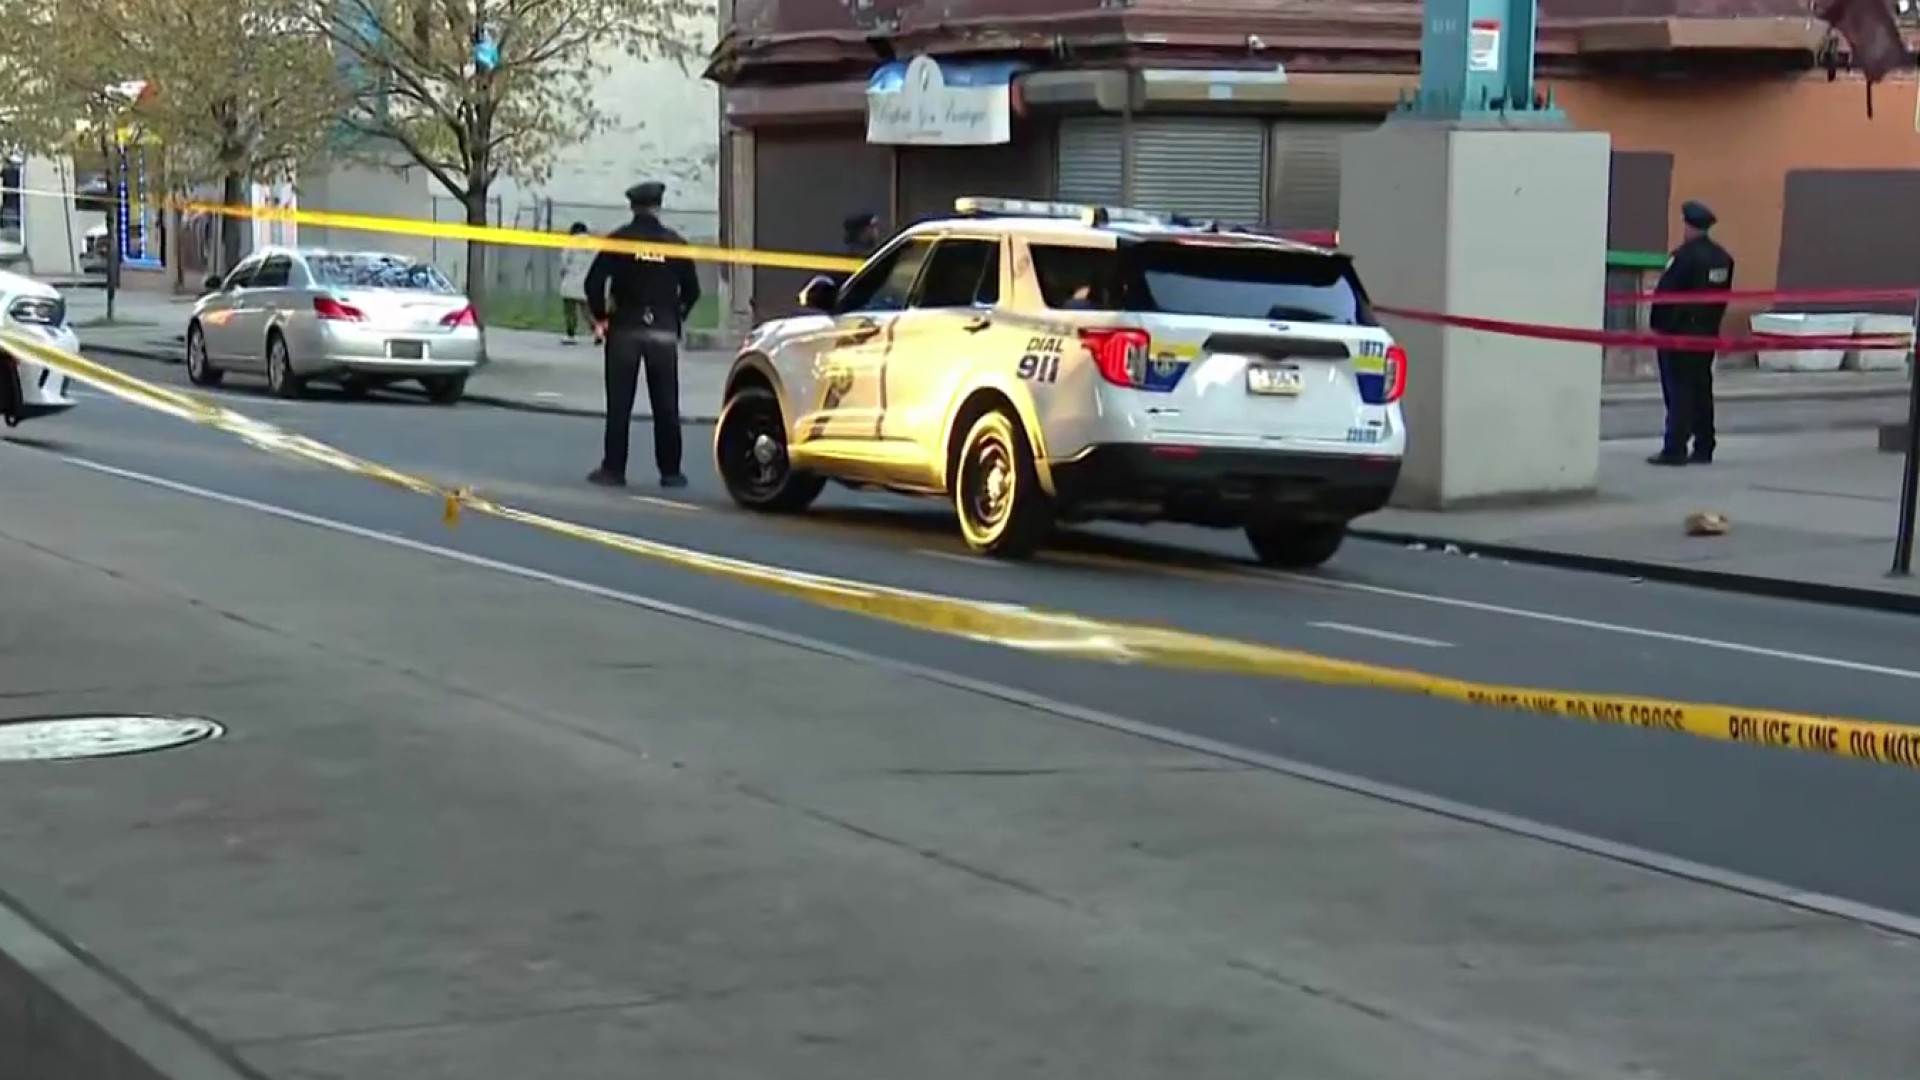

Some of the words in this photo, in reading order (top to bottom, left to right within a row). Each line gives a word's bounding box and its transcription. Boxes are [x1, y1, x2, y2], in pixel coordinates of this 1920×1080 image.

[1027, 337, 1064, 353] DIAL
[1017, 355, 1060, 384] 911
[1630, 704, 1685, 731] CROSS
[1729, 715, 1791, 745] POLICE
[1798, 724, 1840, 752] LINE
[1850, 730, 1881, 762] DO
